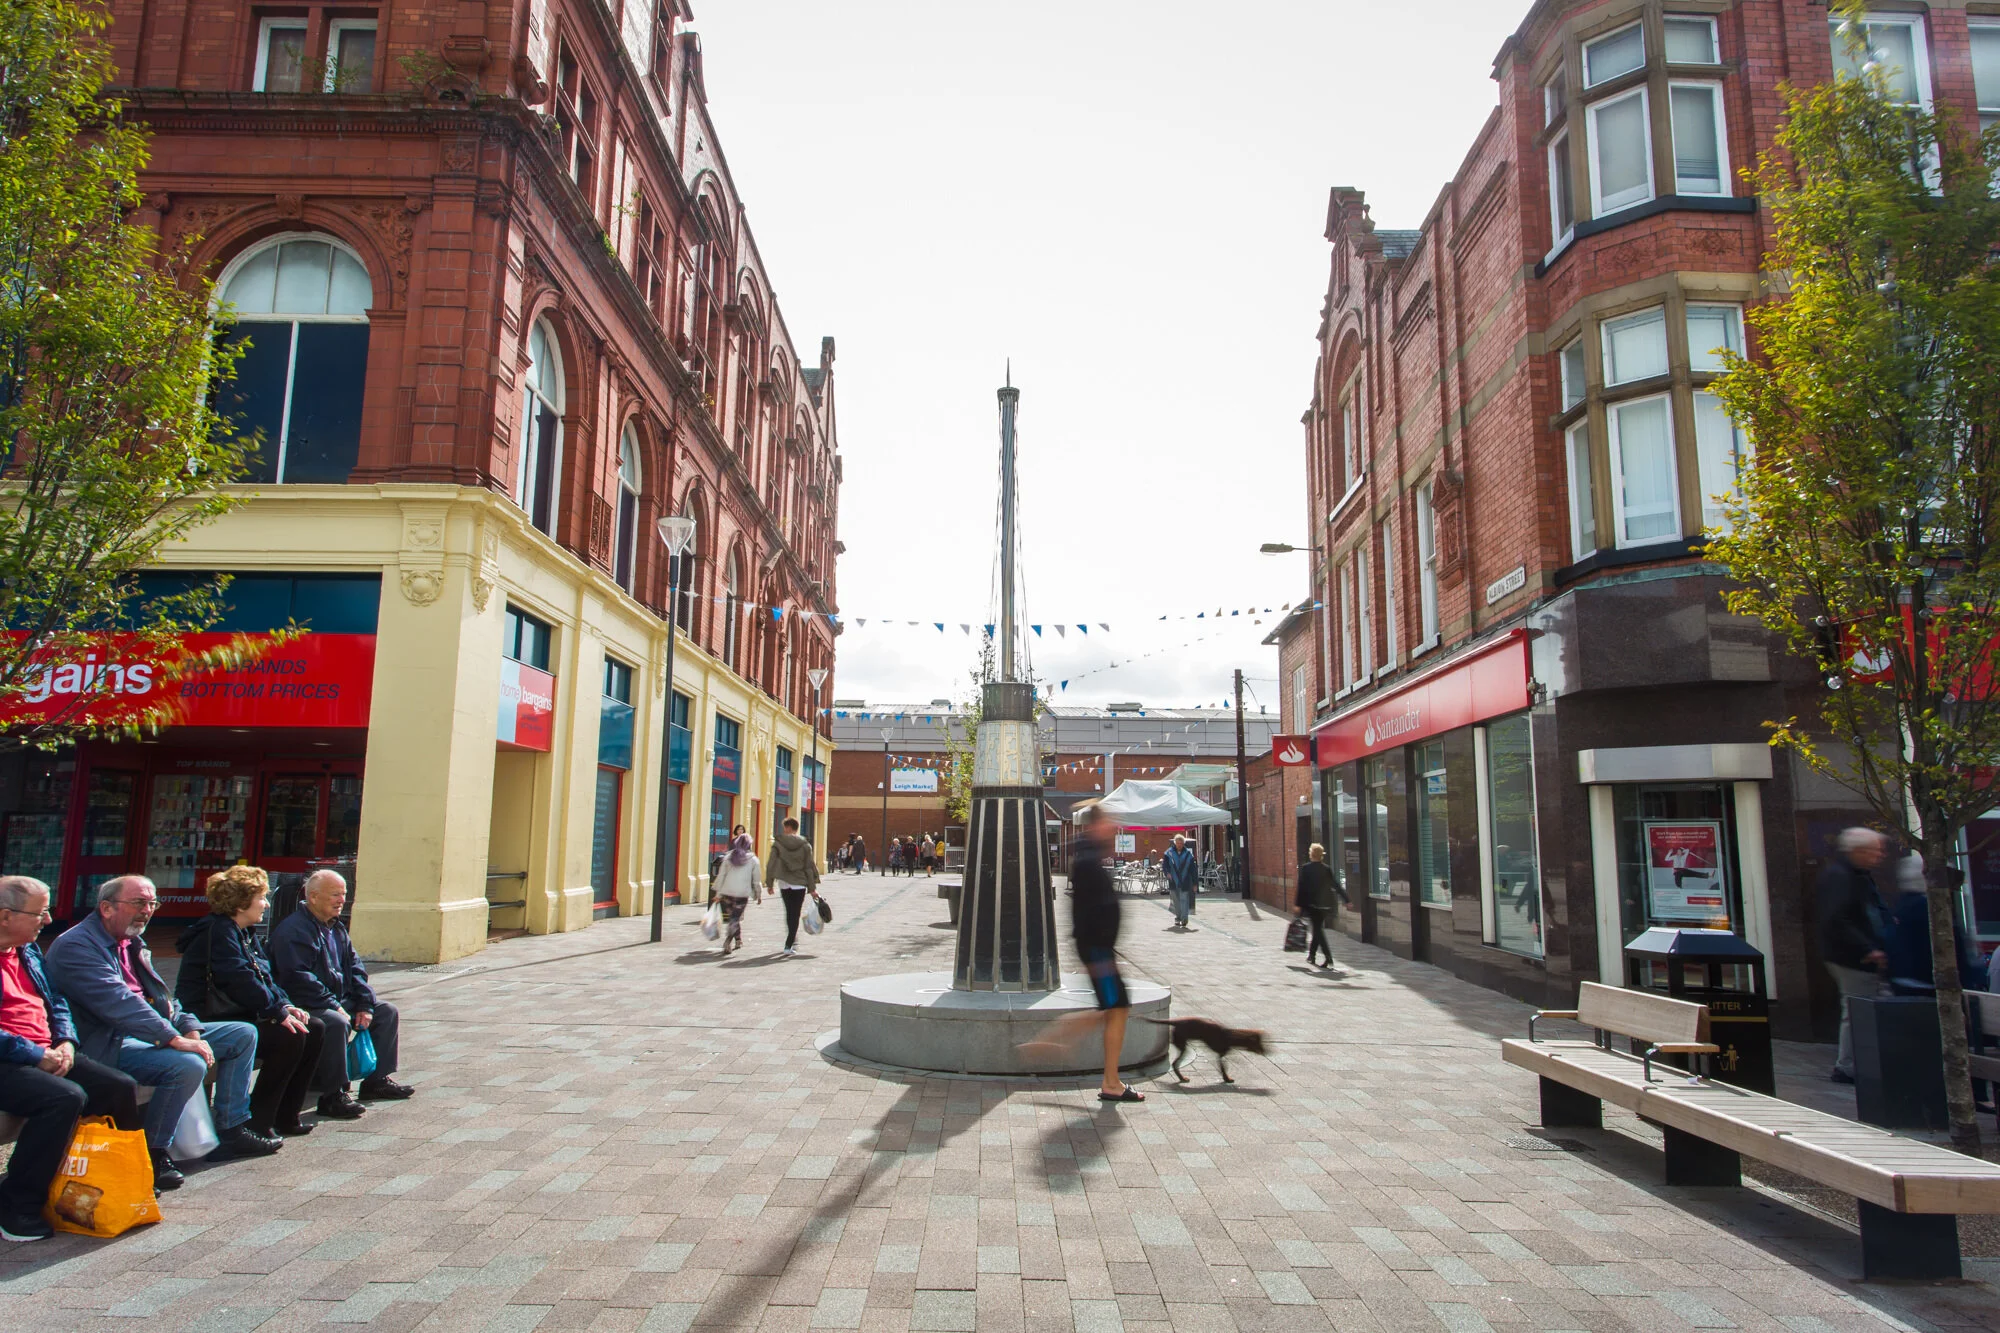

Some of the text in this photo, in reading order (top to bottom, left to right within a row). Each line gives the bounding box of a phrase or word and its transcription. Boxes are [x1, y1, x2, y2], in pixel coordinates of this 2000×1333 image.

[1505, 570, 1523, 590] STREET
[182, 658, 308, 674] TOP BRANDS
[180, 682, 341, 699] BOTTOM PRICES
[521, 686, 553, 712] bargains
[1375, 700, 1420, 742] Santander
[1707, 1002, 1741, 1011] LITTER
